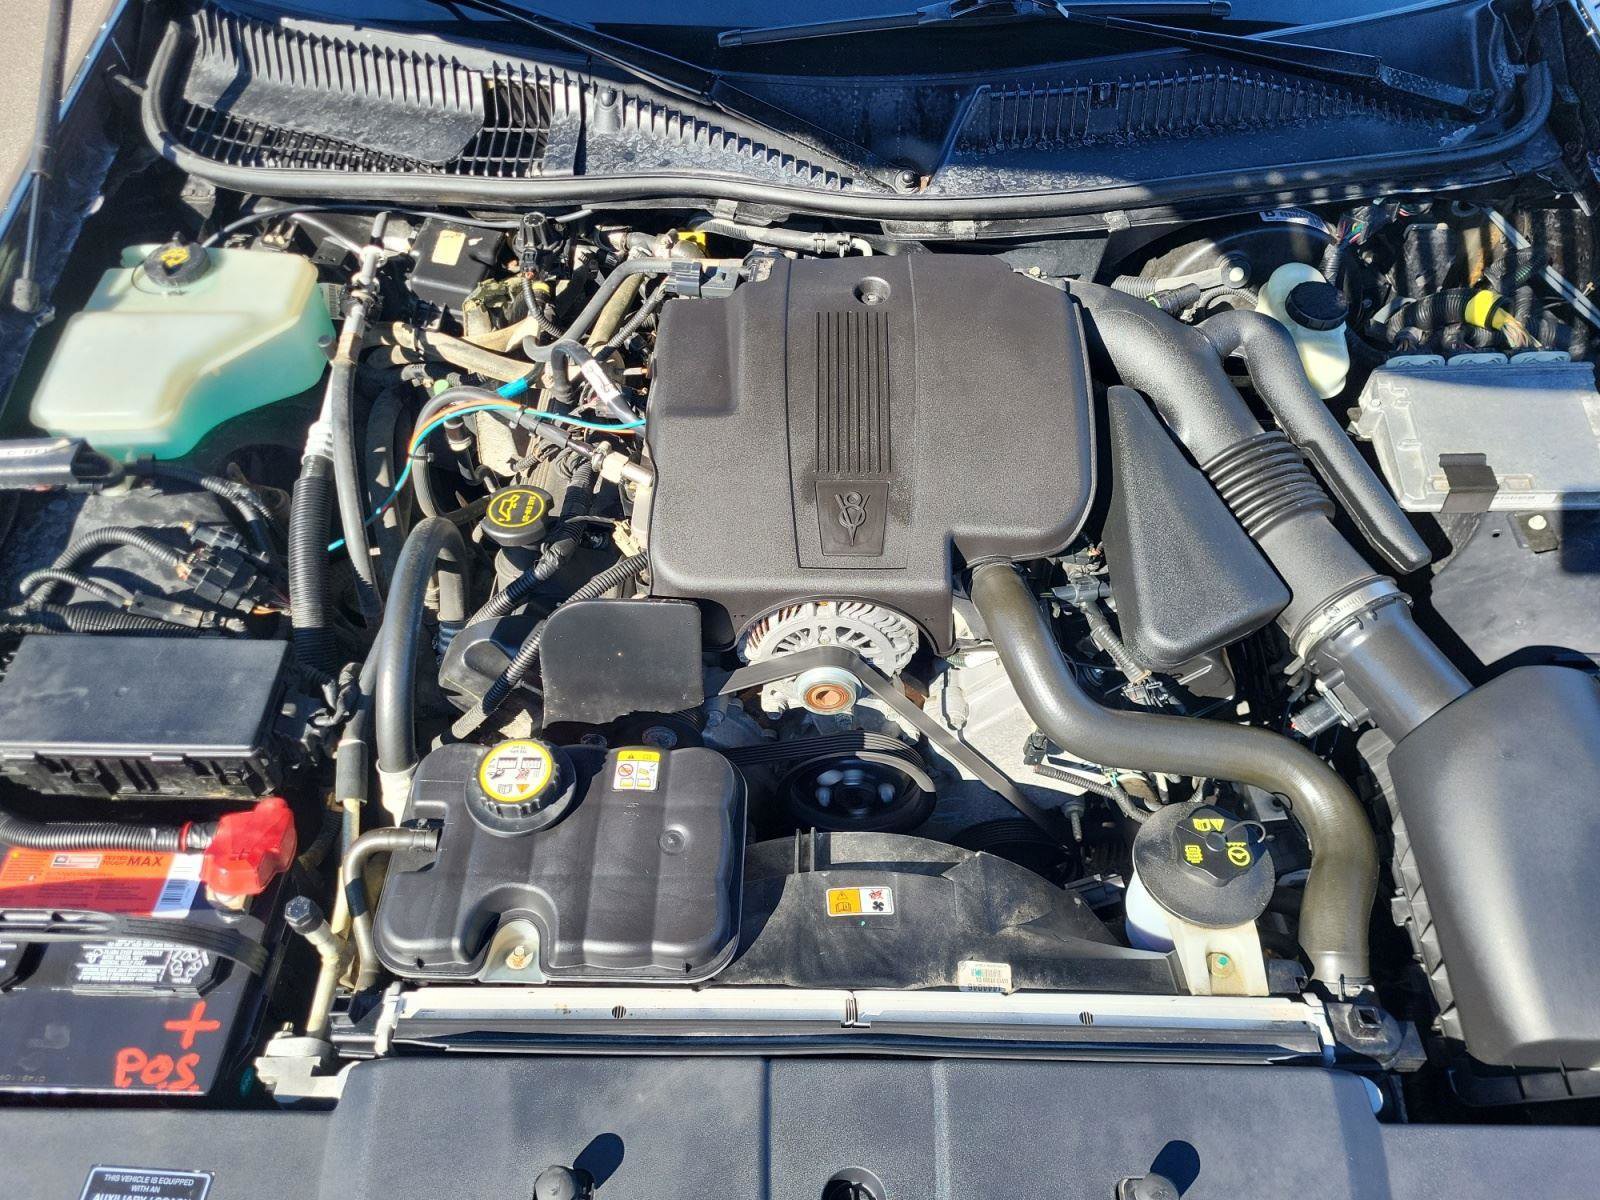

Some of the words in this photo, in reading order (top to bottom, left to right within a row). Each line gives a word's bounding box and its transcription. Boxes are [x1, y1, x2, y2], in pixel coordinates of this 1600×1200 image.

[126, 855, 164, 867] MAX
[104, 1174, 120, 1182] THIS
[120, 1174, 150, 1184] VEHICLE
[150, 1176, 159, 1184] IS
[159, 1177, 195, 1186] EQUIPPED
[131, 1185, 150, 1193] WITH
[150, 1185, 161, 1194] AN
